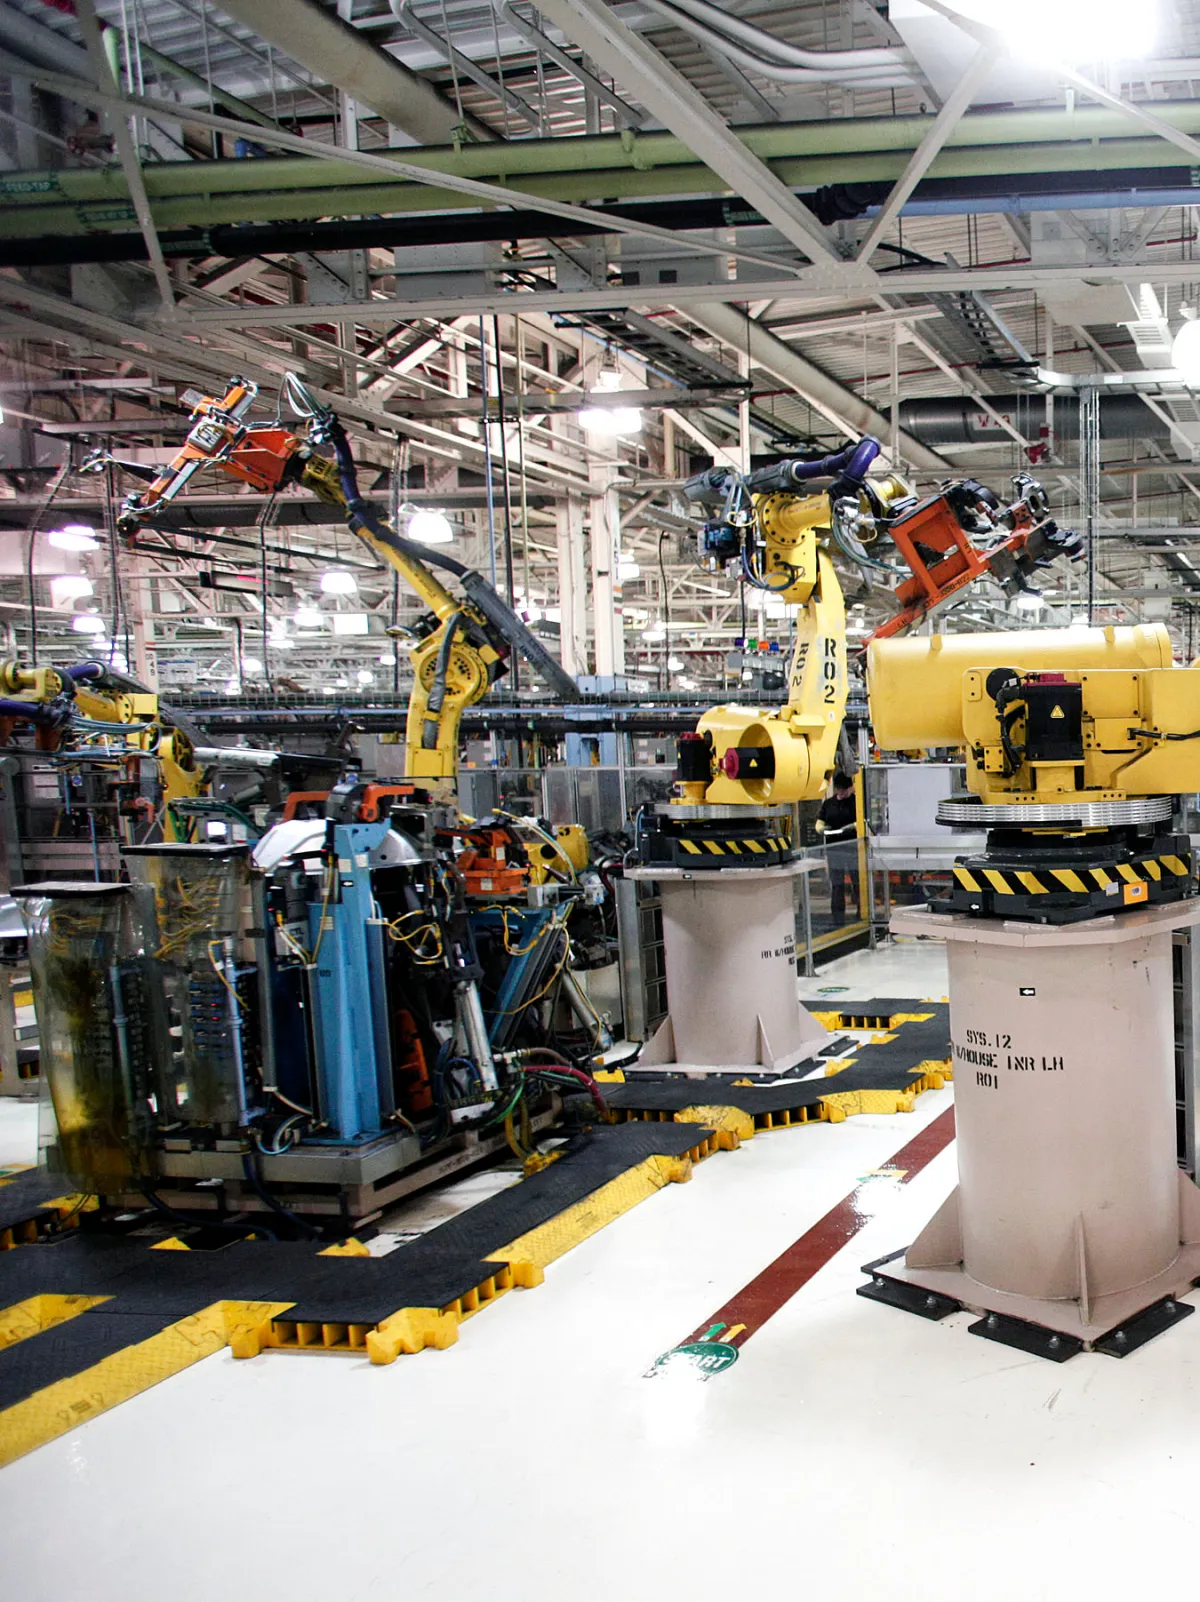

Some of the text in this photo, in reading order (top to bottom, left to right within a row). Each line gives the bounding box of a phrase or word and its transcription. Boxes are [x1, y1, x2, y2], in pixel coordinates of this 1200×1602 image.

[792, 642, 810, 688] R02
[824, 637, 837, 704] R02
[1042, 1056, 1064, 1071] LH
